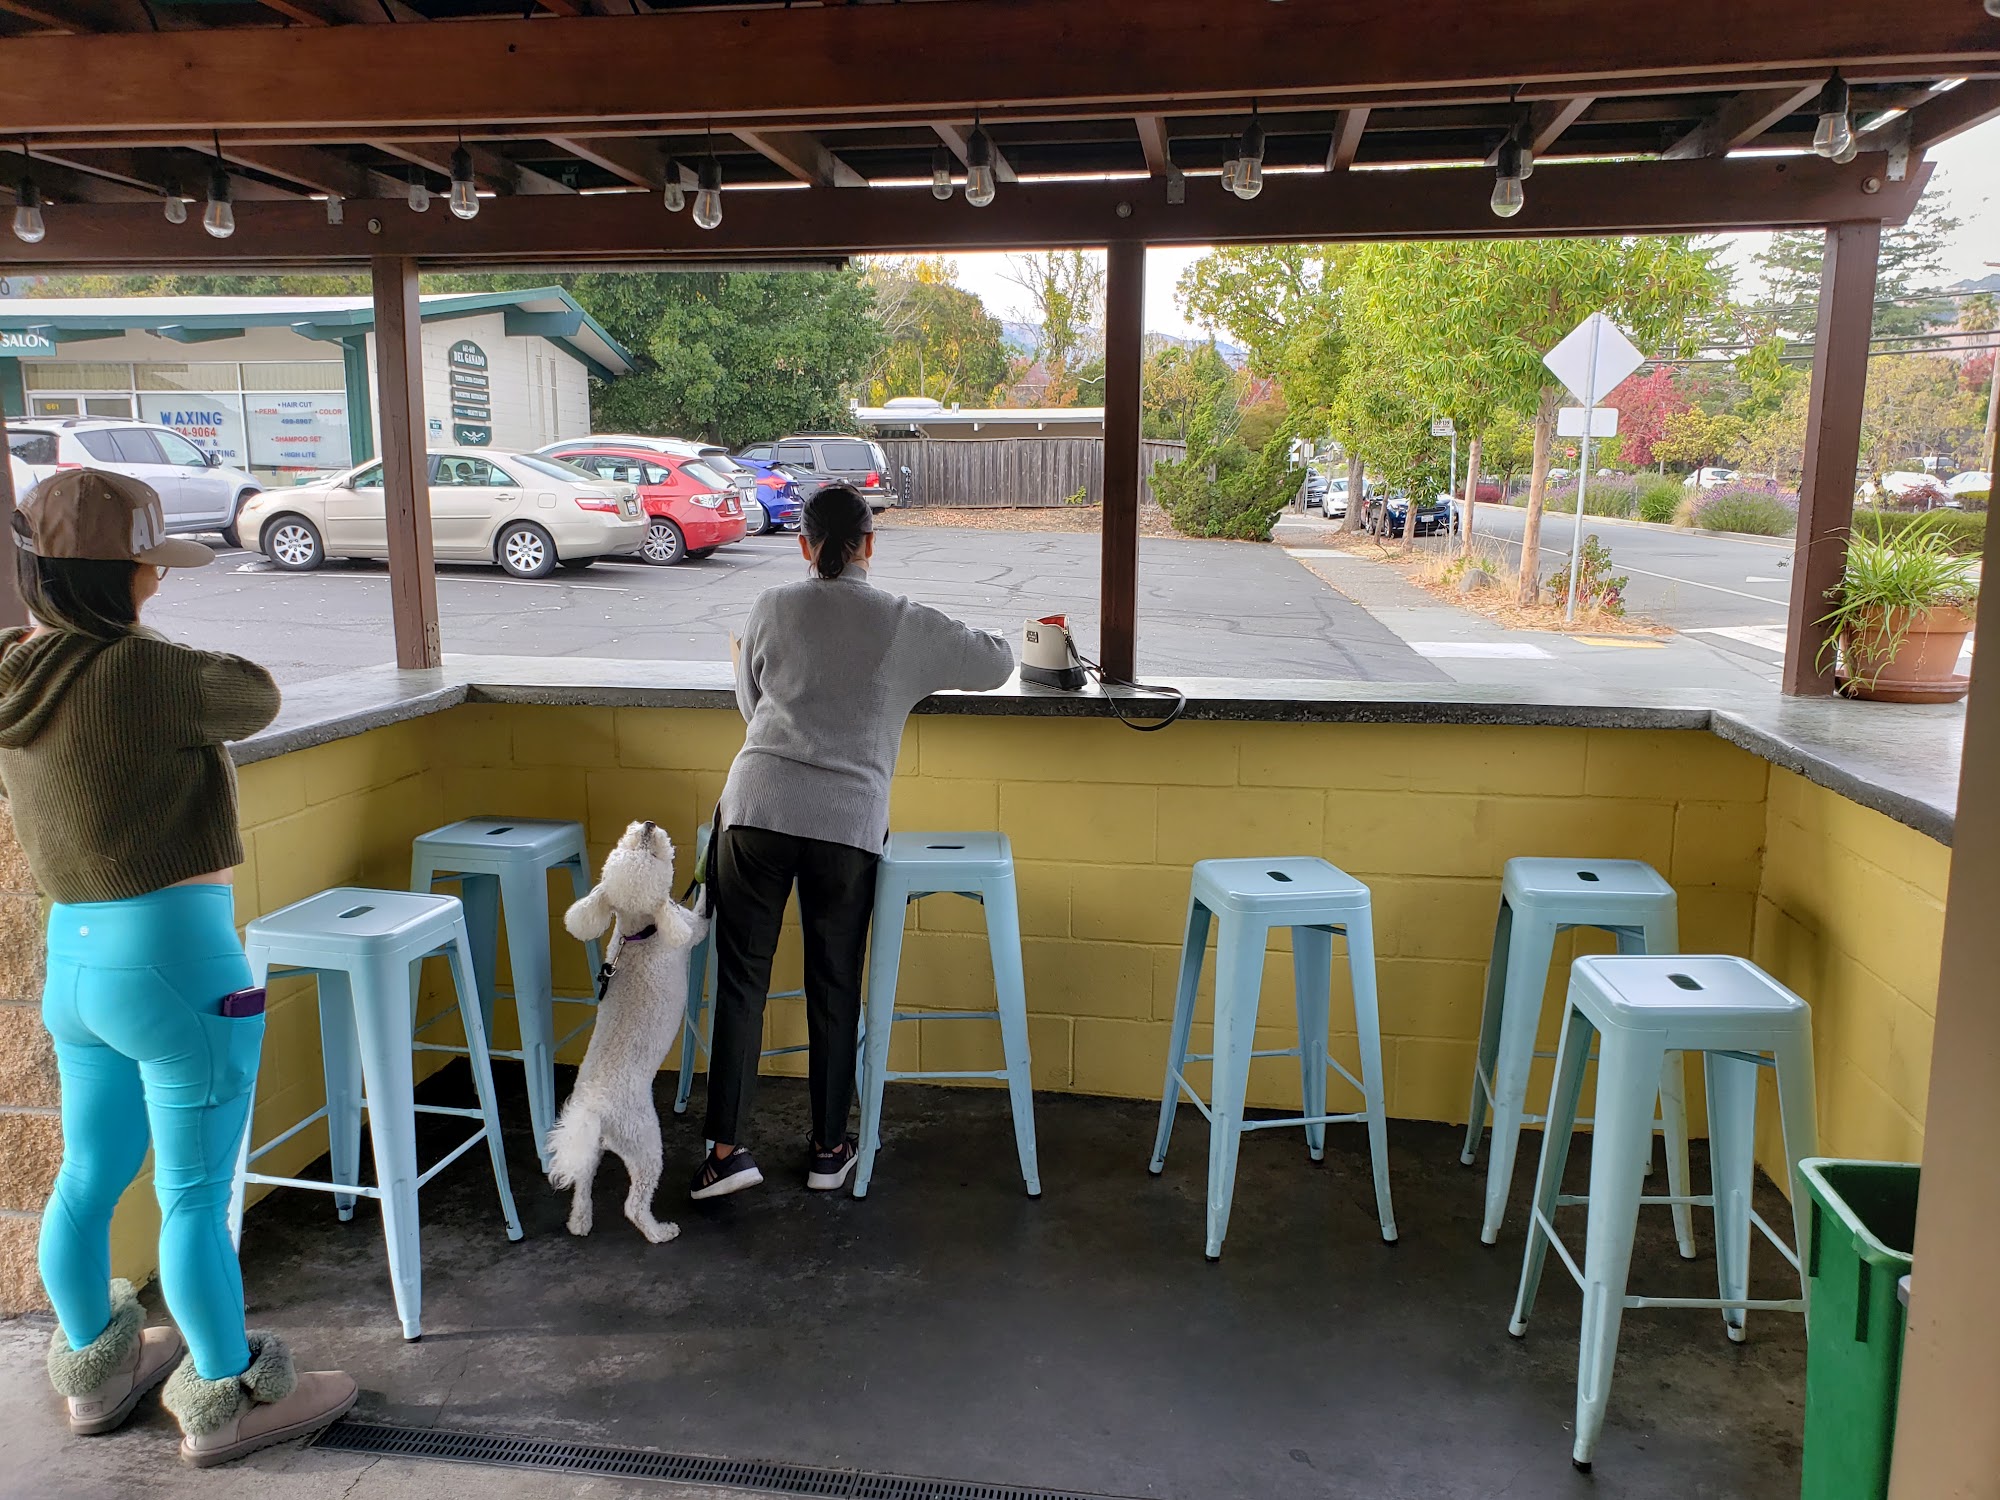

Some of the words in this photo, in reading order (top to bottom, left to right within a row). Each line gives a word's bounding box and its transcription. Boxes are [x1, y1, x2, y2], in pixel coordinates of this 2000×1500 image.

[2, 334, 50, 348] SALON
[454, 351, 464, 363] DEL
[160, 411, 222, 426] WAXING
[275, 435, 309, 443] SHAMPOO
[310, 435, 322, 443] SET
